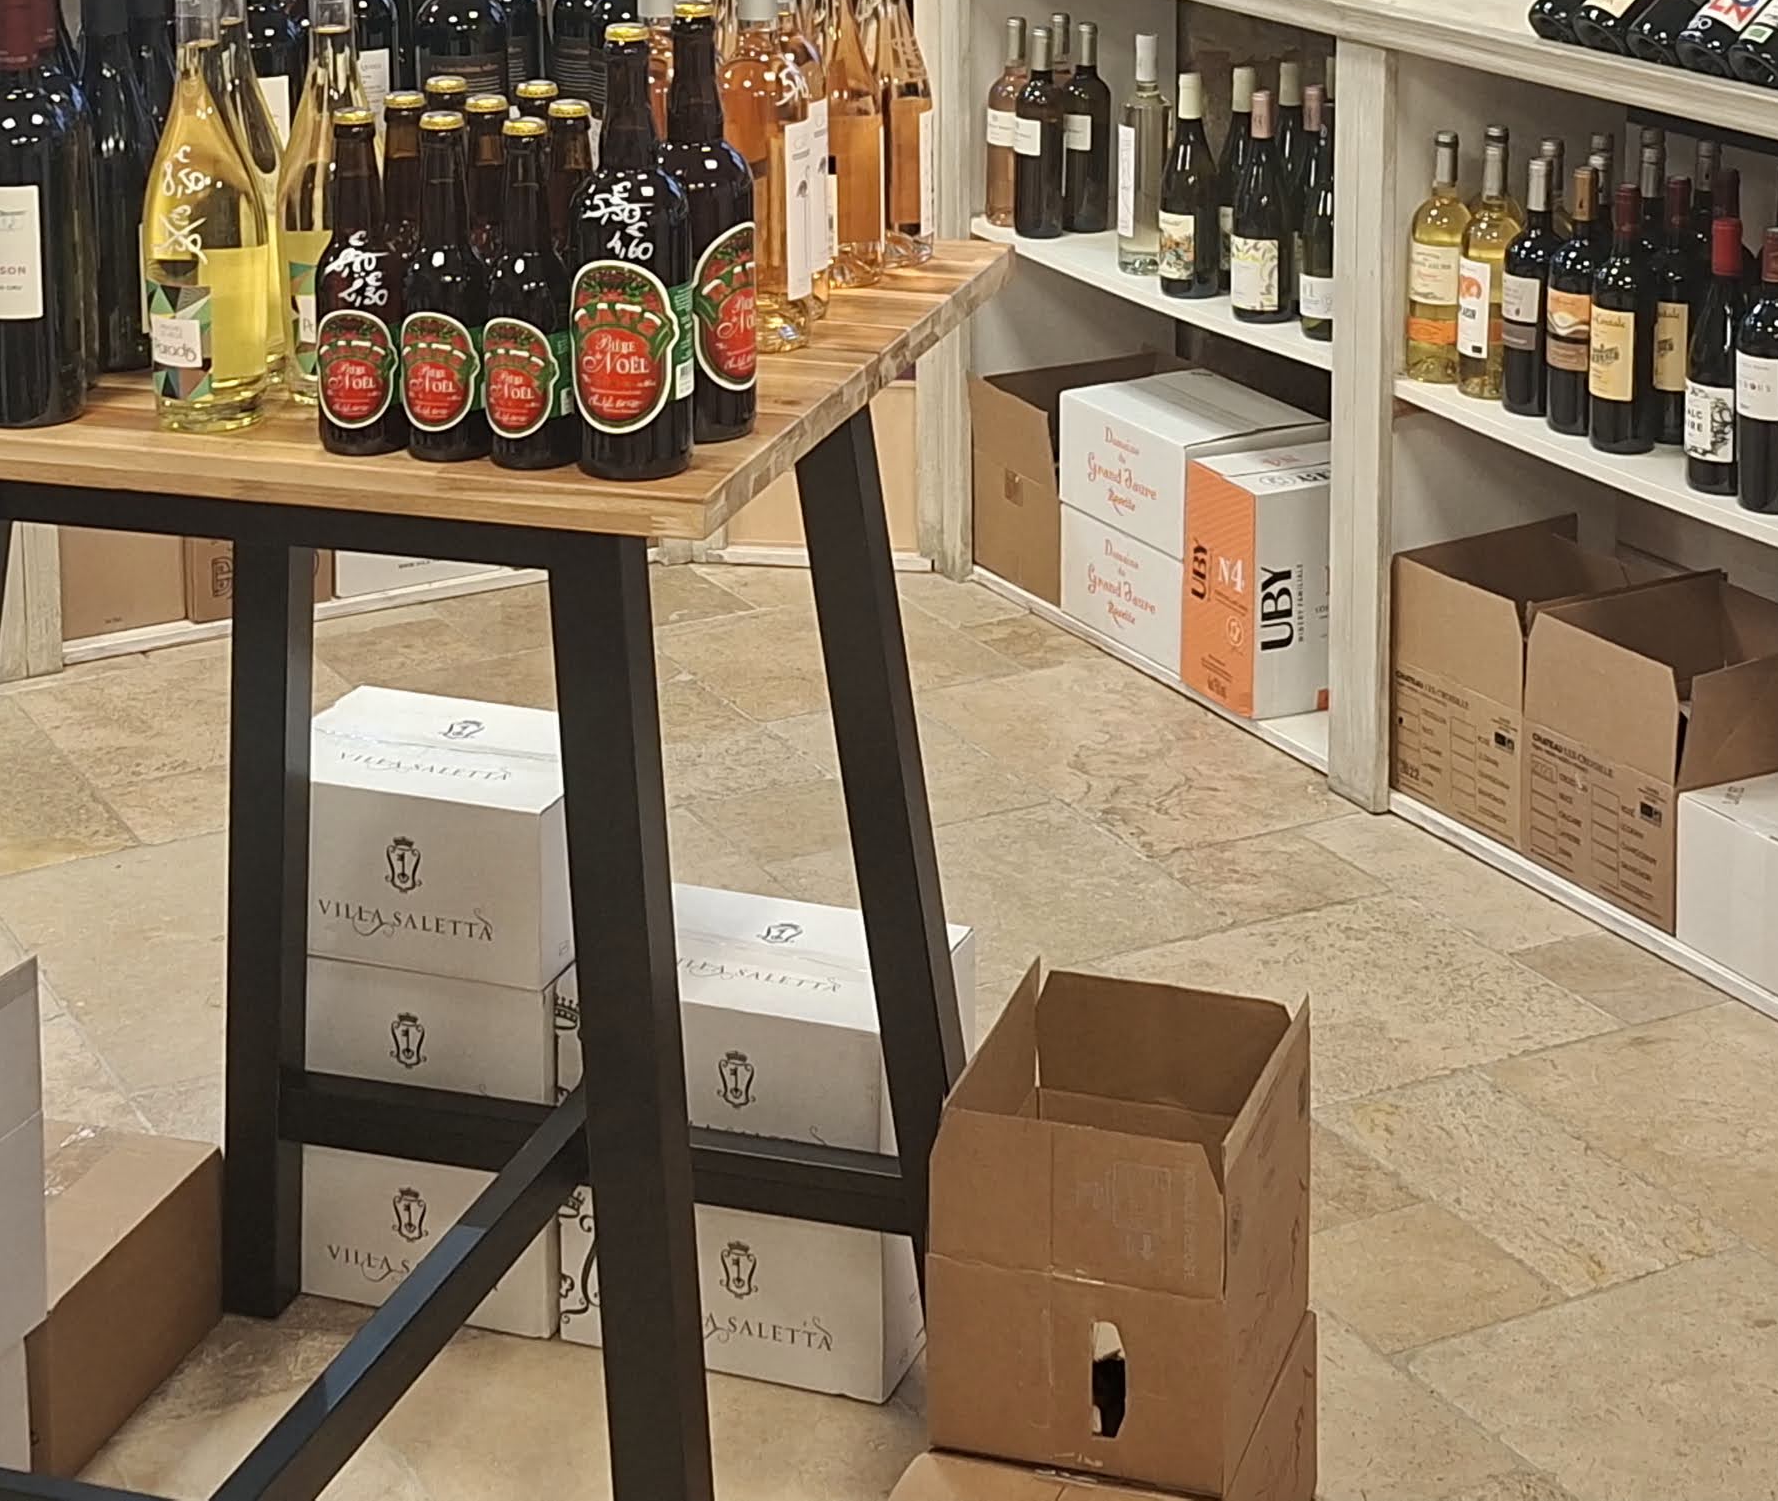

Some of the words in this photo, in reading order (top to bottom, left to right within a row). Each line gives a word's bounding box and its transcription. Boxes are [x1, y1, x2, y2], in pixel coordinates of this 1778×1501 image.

[582, 351, 651, 375] NOËL
[1190, 538, 1209, 602] UBY
[1260, 565, 1294, 652] UBY
[318, 898, 391, 935] VILLA
[392, 908, 494, 942] SALETTA
[735, 967, 842, 994] SALETTA
[325, 1242, 395, 1277] VILLA
[727, 1316, 834, 1353] SALETTA
